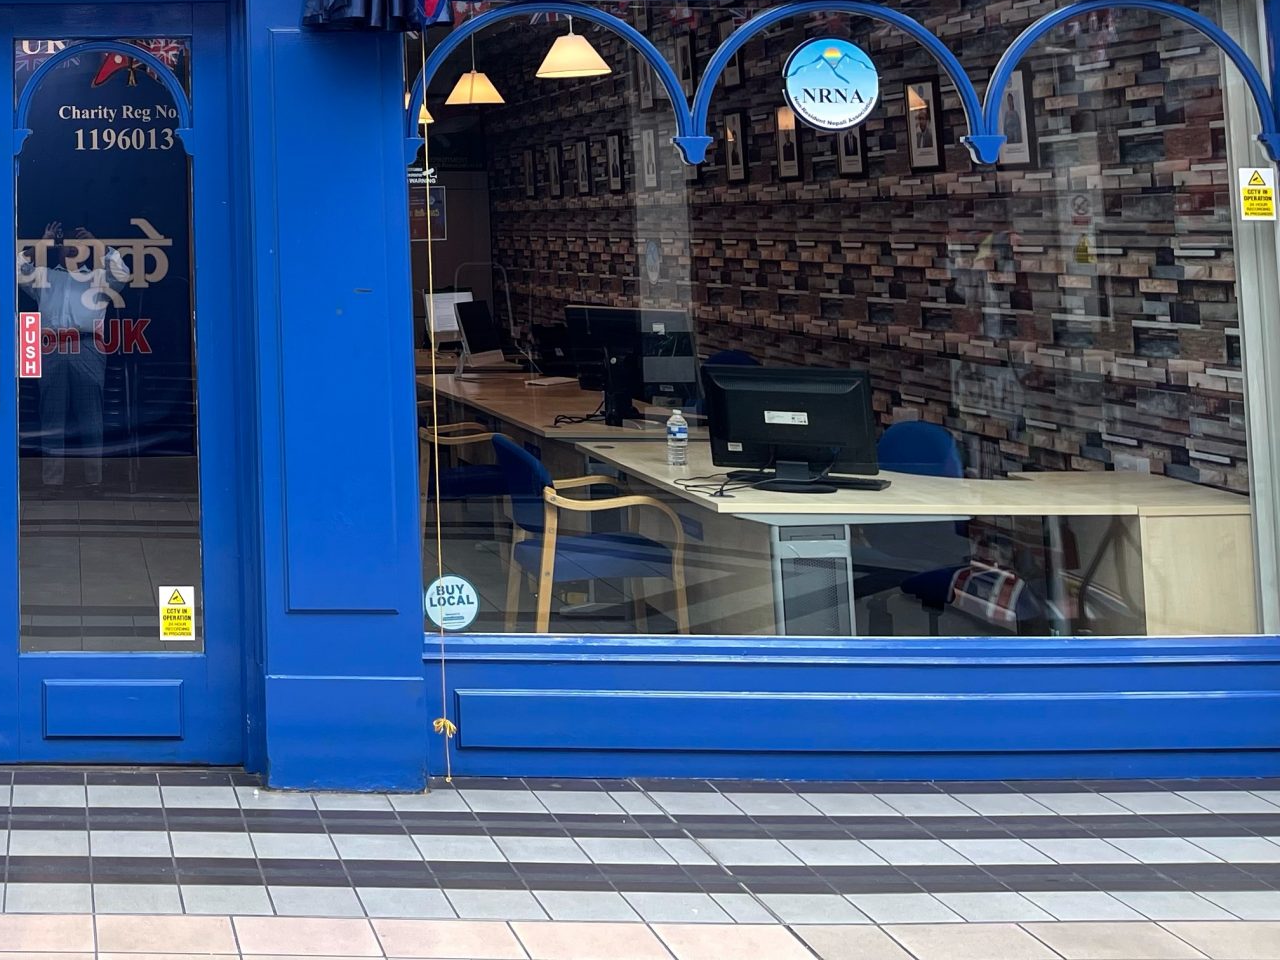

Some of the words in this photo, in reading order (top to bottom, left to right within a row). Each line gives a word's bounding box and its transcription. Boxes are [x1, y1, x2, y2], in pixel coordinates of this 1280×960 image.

[802, 87, 865, 104] NRNA
[58, 105, 118, 123] Charity
[122, 105, 152, 122] Reg
[74, 127, 175, 151] 1196013
[24, 315, 37, 375] PUSH
[93, 318, 153, 354] UK
[435, 583, 465, 596] BUY
[429, 594, 475, 608] LOCAL
